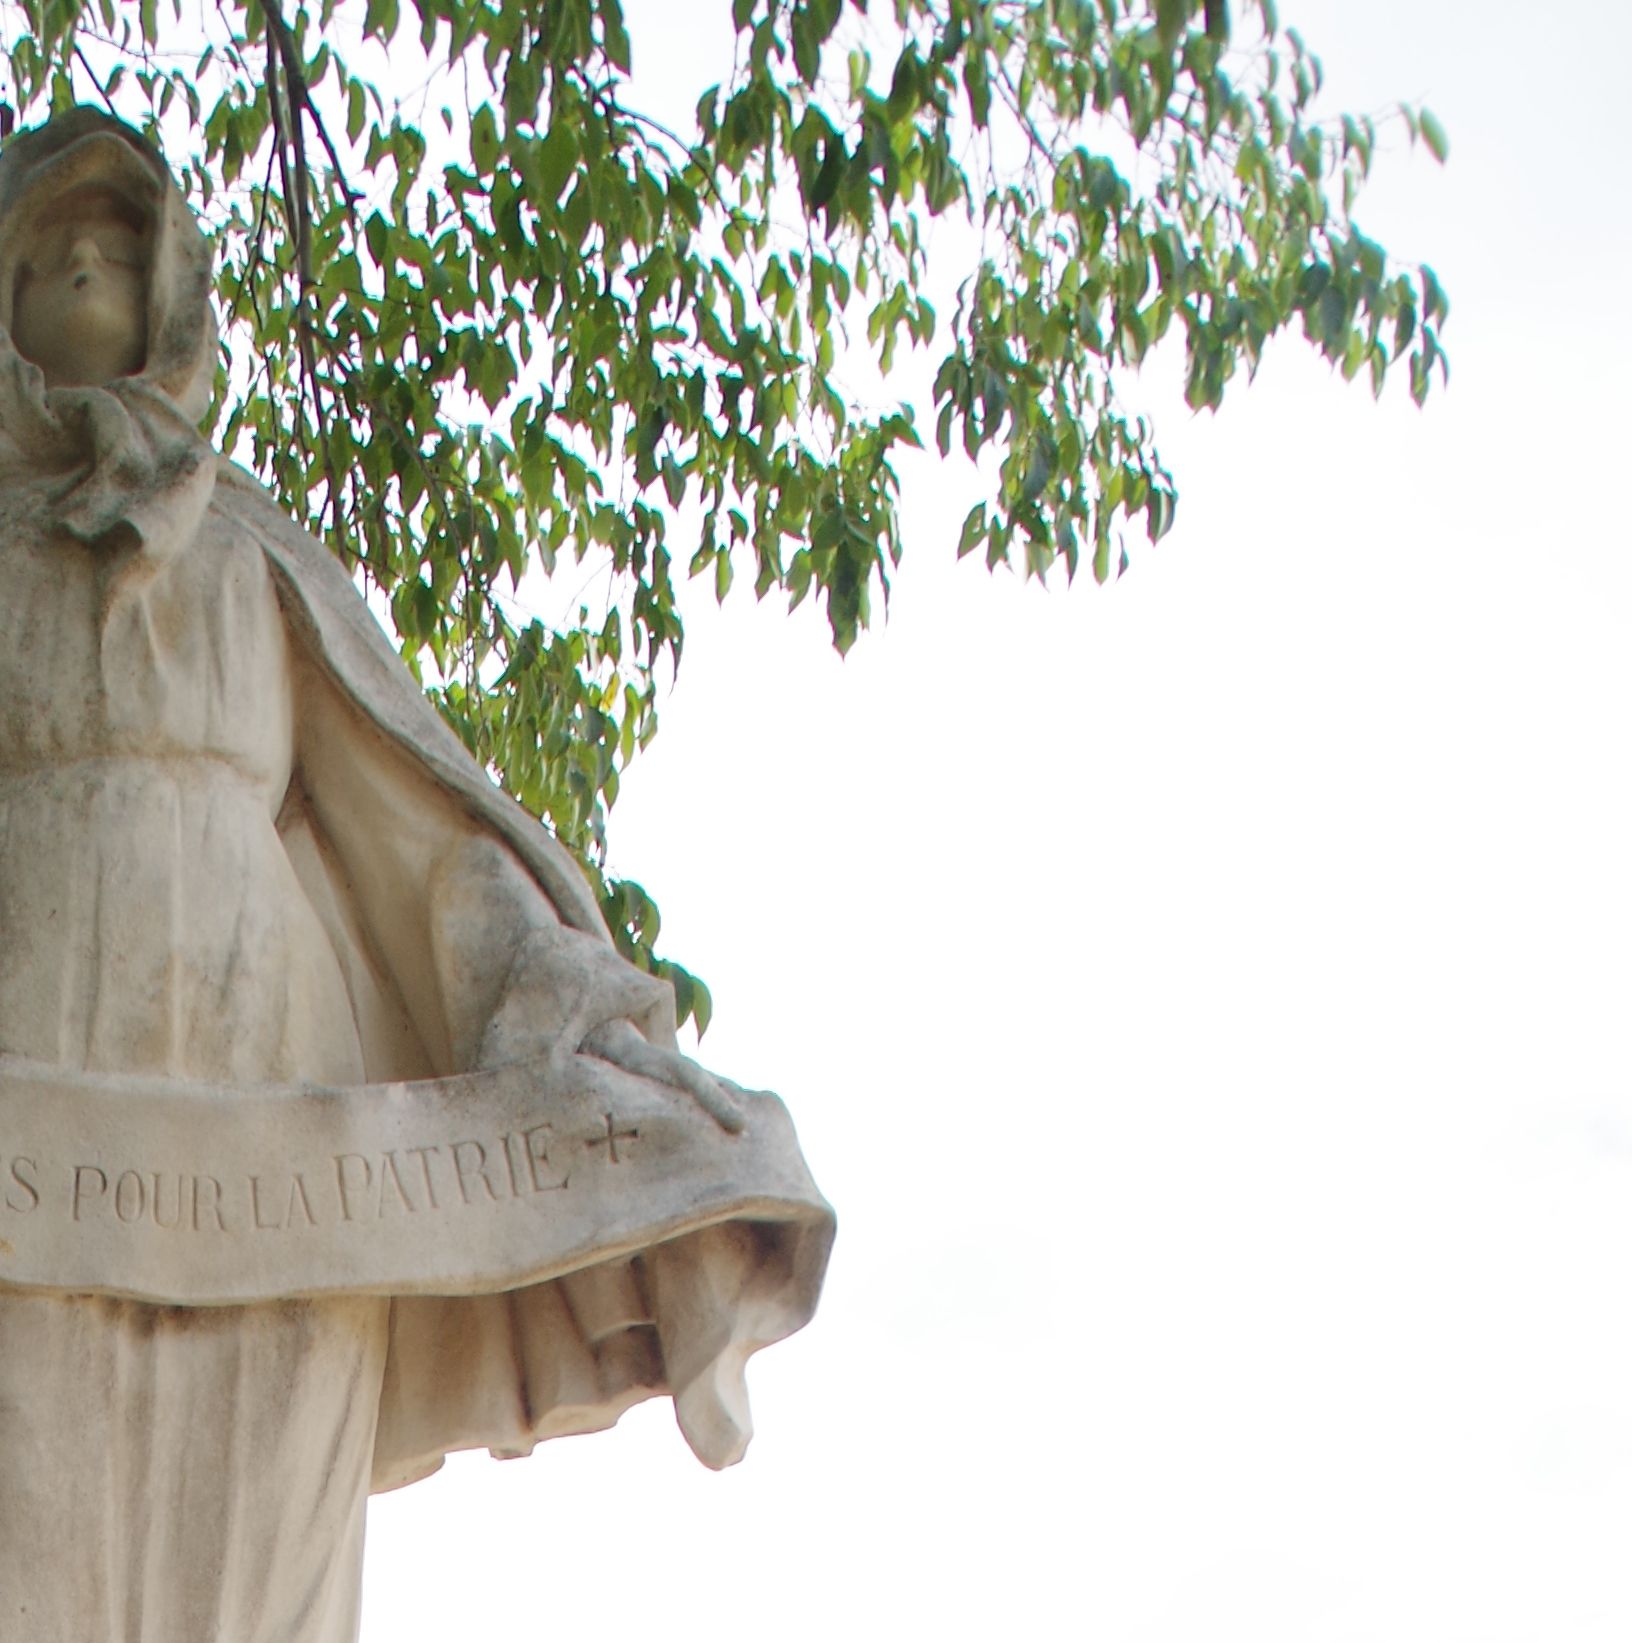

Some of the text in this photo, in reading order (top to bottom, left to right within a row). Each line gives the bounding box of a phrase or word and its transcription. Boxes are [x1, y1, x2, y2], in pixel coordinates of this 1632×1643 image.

[71, 1164, 227, 1232] POUR
[248, 1172, 318, 1231] LA
[332, 1121, 569, 1221] PATRIE
